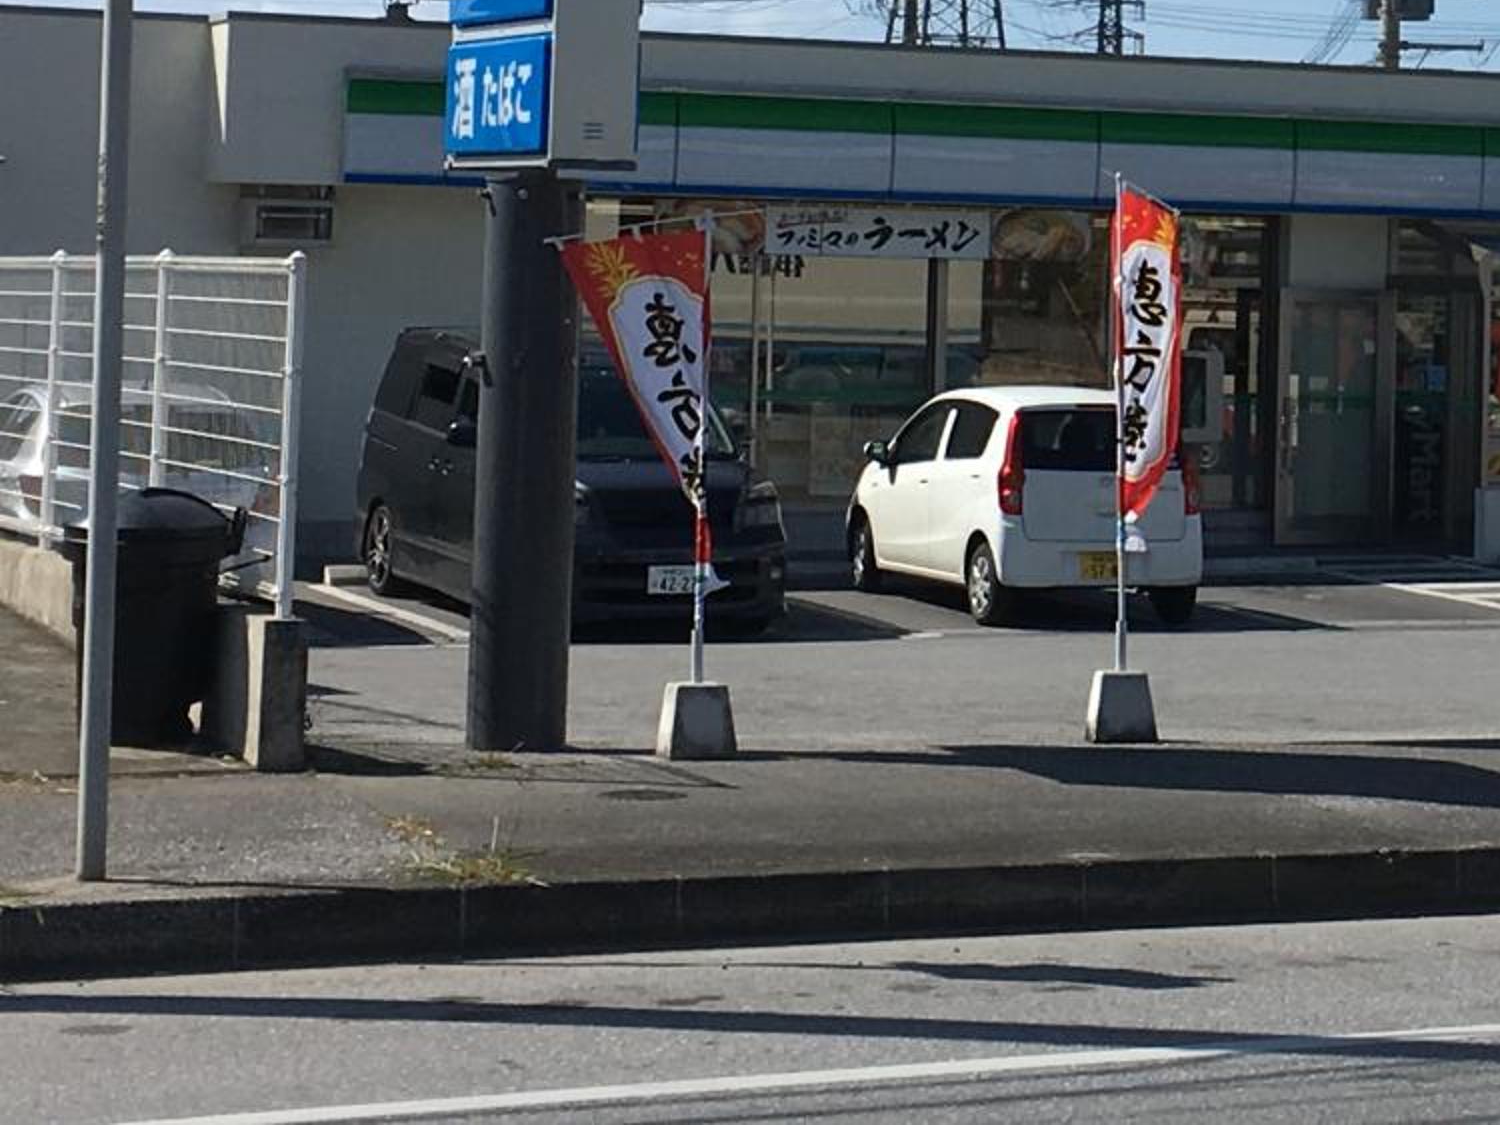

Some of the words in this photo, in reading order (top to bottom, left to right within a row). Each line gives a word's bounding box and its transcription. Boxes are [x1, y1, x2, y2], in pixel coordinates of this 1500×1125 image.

[452, 57, 478, 140] 酒
[481, 59, 533, 127] たばこ
